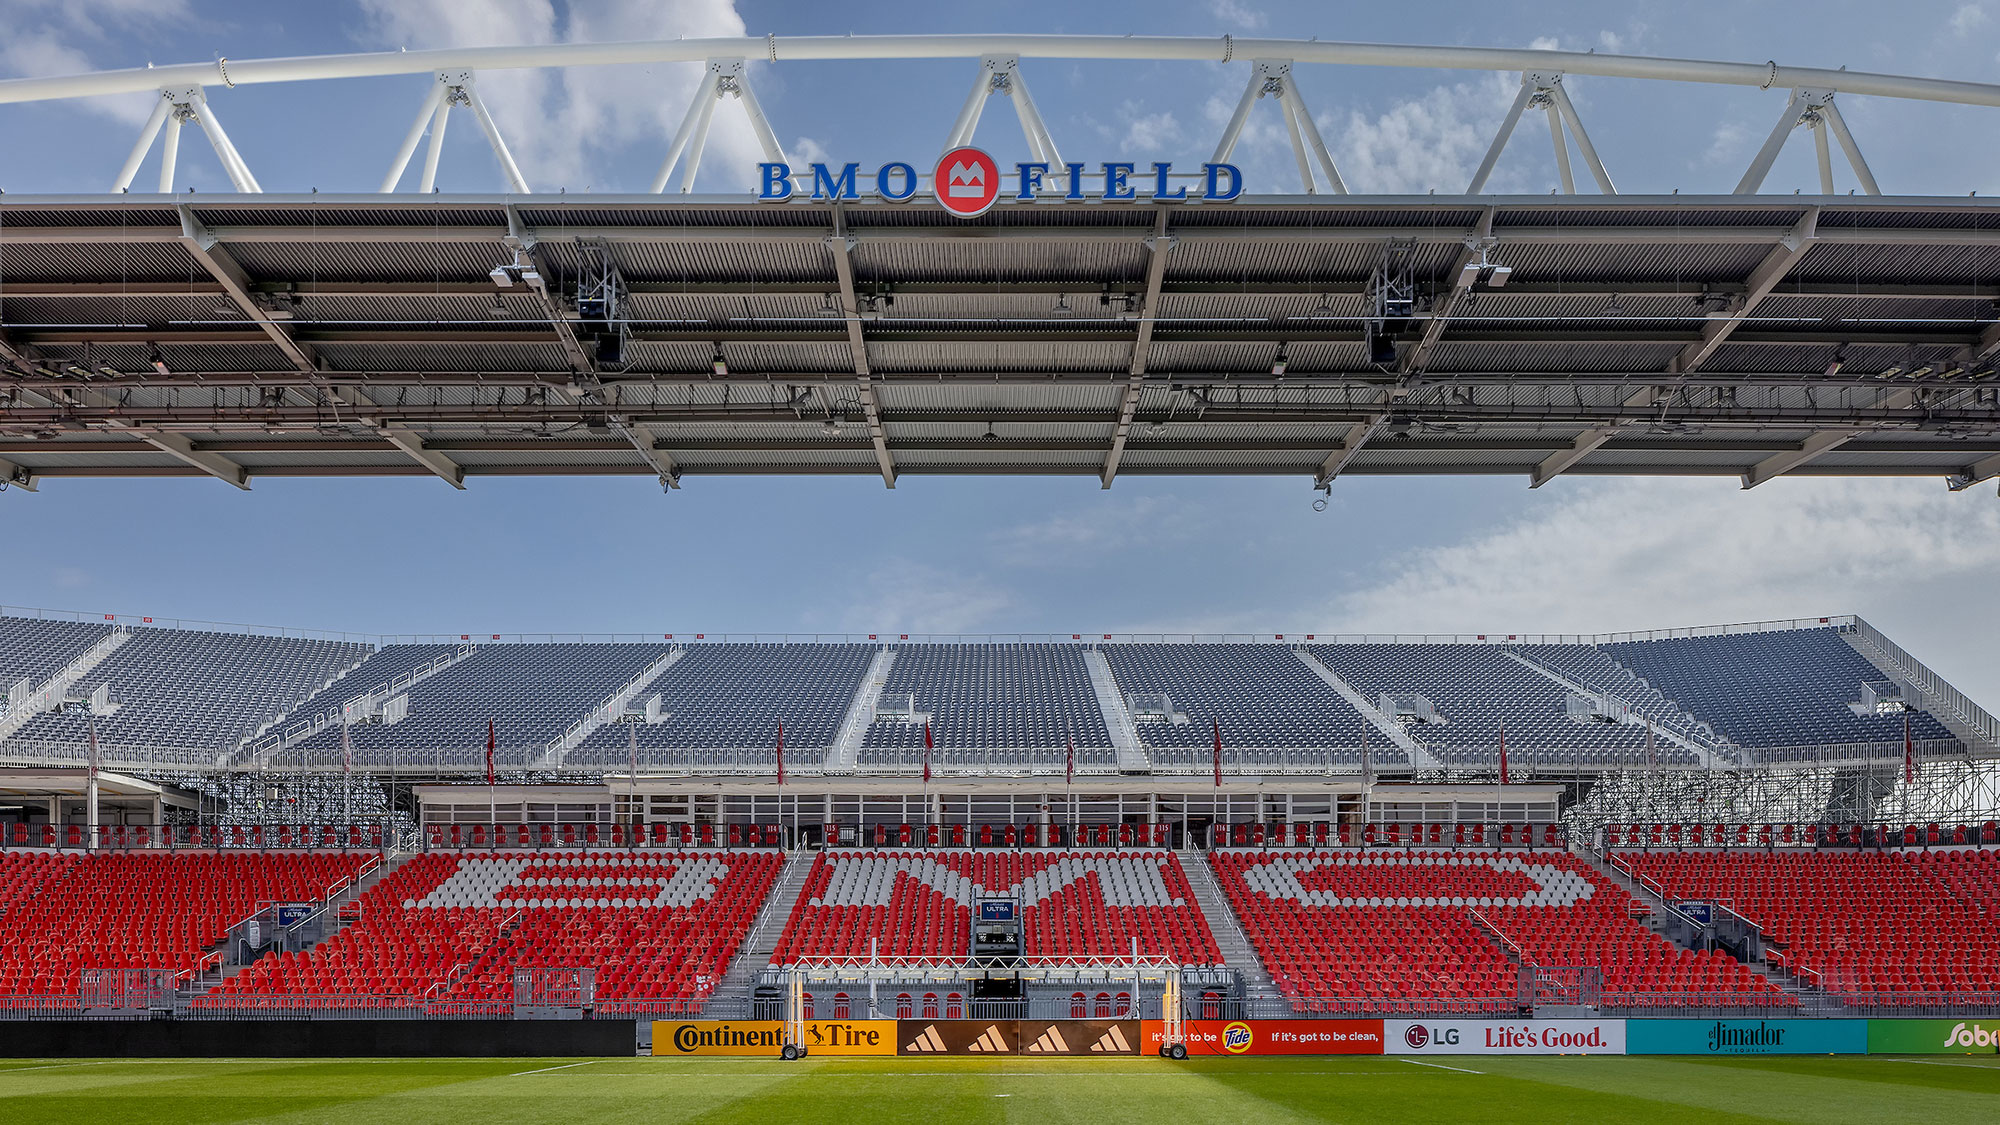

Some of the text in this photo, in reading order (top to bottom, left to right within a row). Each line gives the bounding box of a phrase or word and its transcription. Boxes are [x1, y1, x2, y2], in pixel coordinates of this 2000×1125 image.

[758, 162, 1244, 202] BMO FIELD
[370, 825, 380, 833] 113
[826, 824, 836, 832] 115
[1159, 824, 1169, 832] 115
[1610, 824, 1620, 832] 117
[673, 1024, 880, 1052] Continent Tire
[1189, 1033, 1202, 1042] to
[1203, 1032, 1218, 1042] be
[1225, 1028, 1251, 1049] Tide
[1271, 1031, 1379, 1043] If it's got to be clean,
[1433, 1028, 1460, 1045] LG
[1485, 1026, 1607, 1048] Life's Good.
